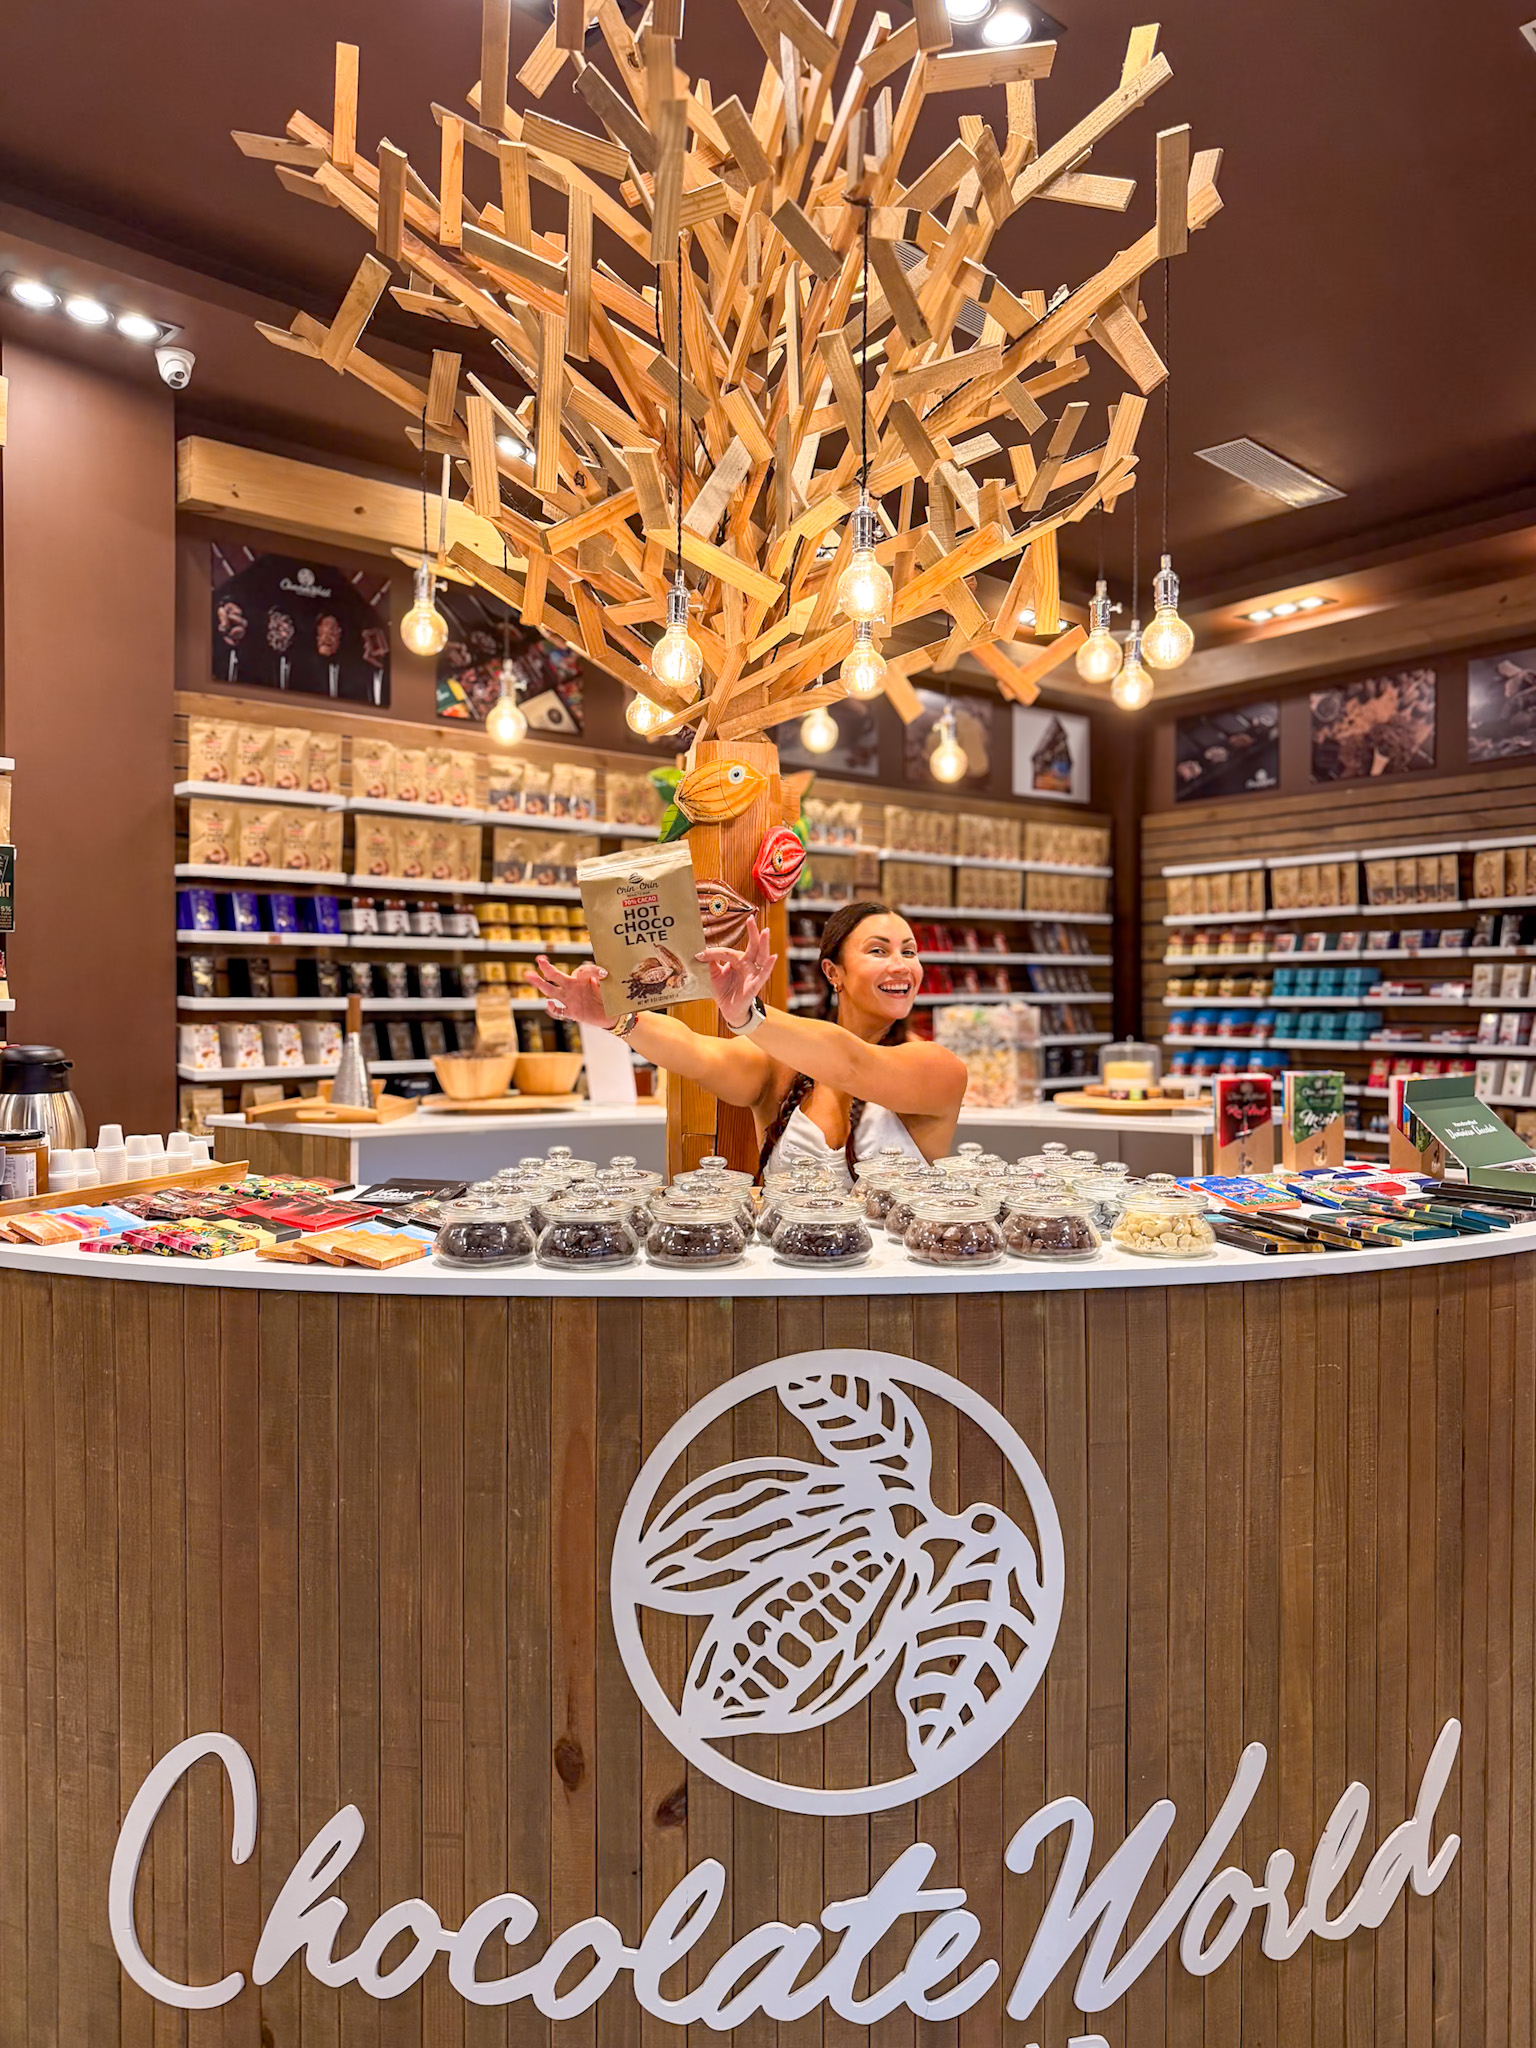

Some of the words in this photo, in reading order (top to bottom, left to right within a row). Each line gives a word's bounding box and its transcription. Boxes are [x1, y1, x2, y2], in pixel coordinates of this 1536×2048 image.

[637, 895, 657, 904] CACAO
[624, 905, 660, 920] HOT
[613, 915, 675, 935] CHOCO
[624, 929, 668, 946] LATE
[109, 1732, 999, 2031] Chocolate
[1005, 1717, 1462, 2021] World
